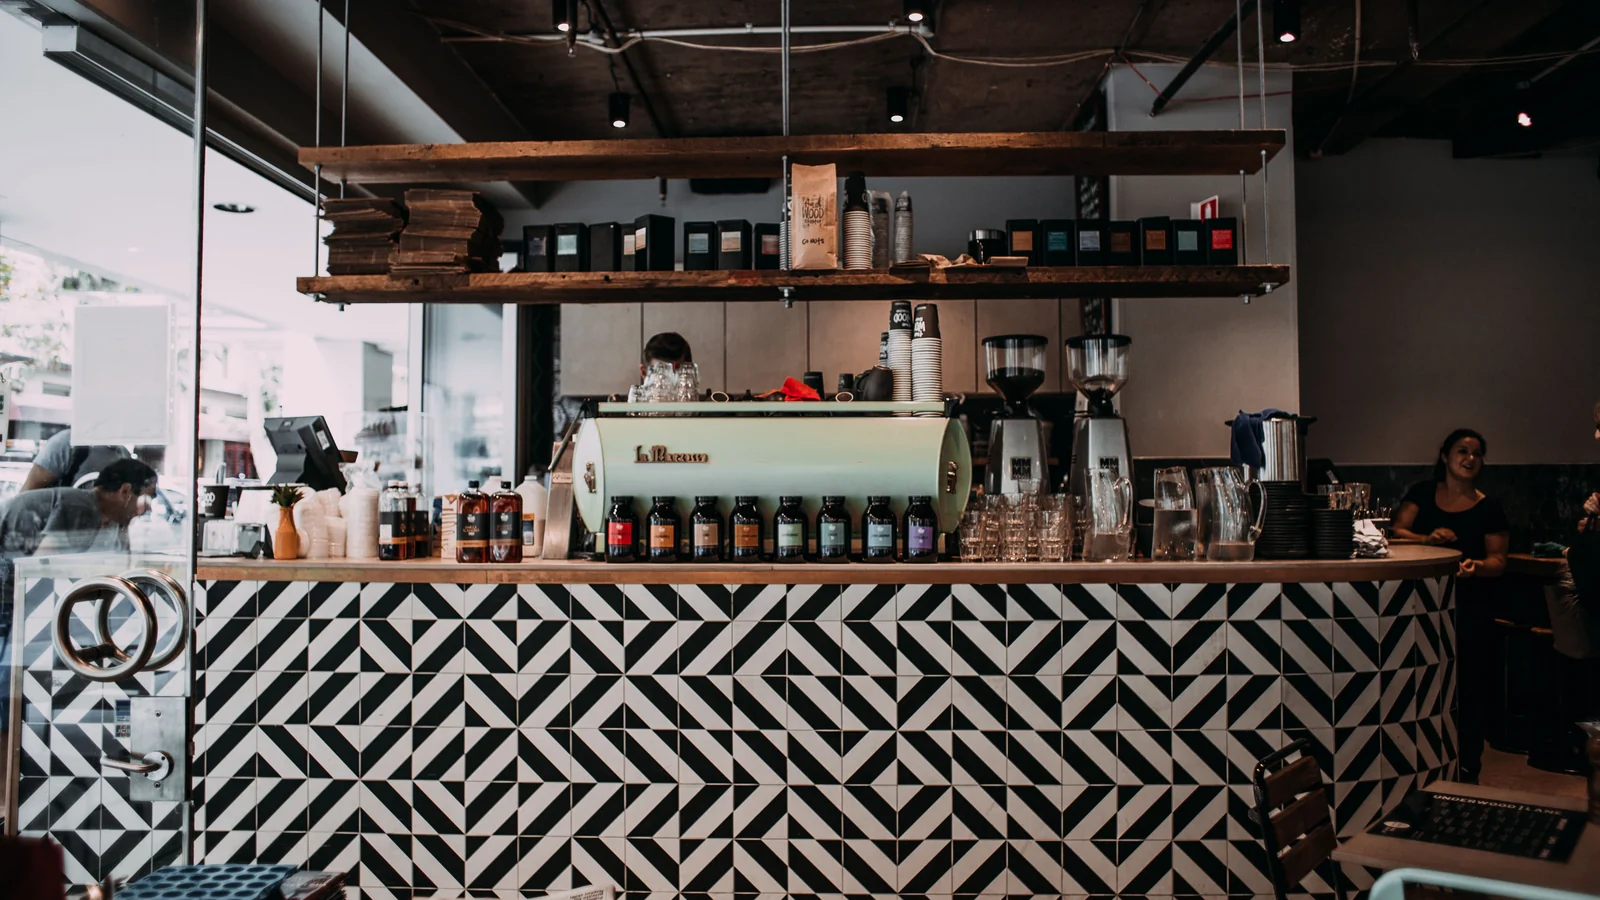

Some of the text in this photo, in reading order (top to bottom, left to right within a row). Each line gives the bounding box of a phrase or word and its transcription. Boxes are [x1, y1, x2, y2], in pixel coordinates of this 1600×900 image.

[802, 207, 824, 219] WOOD
[1433, 794, 1563, 816] UNDERWOOD LANE
